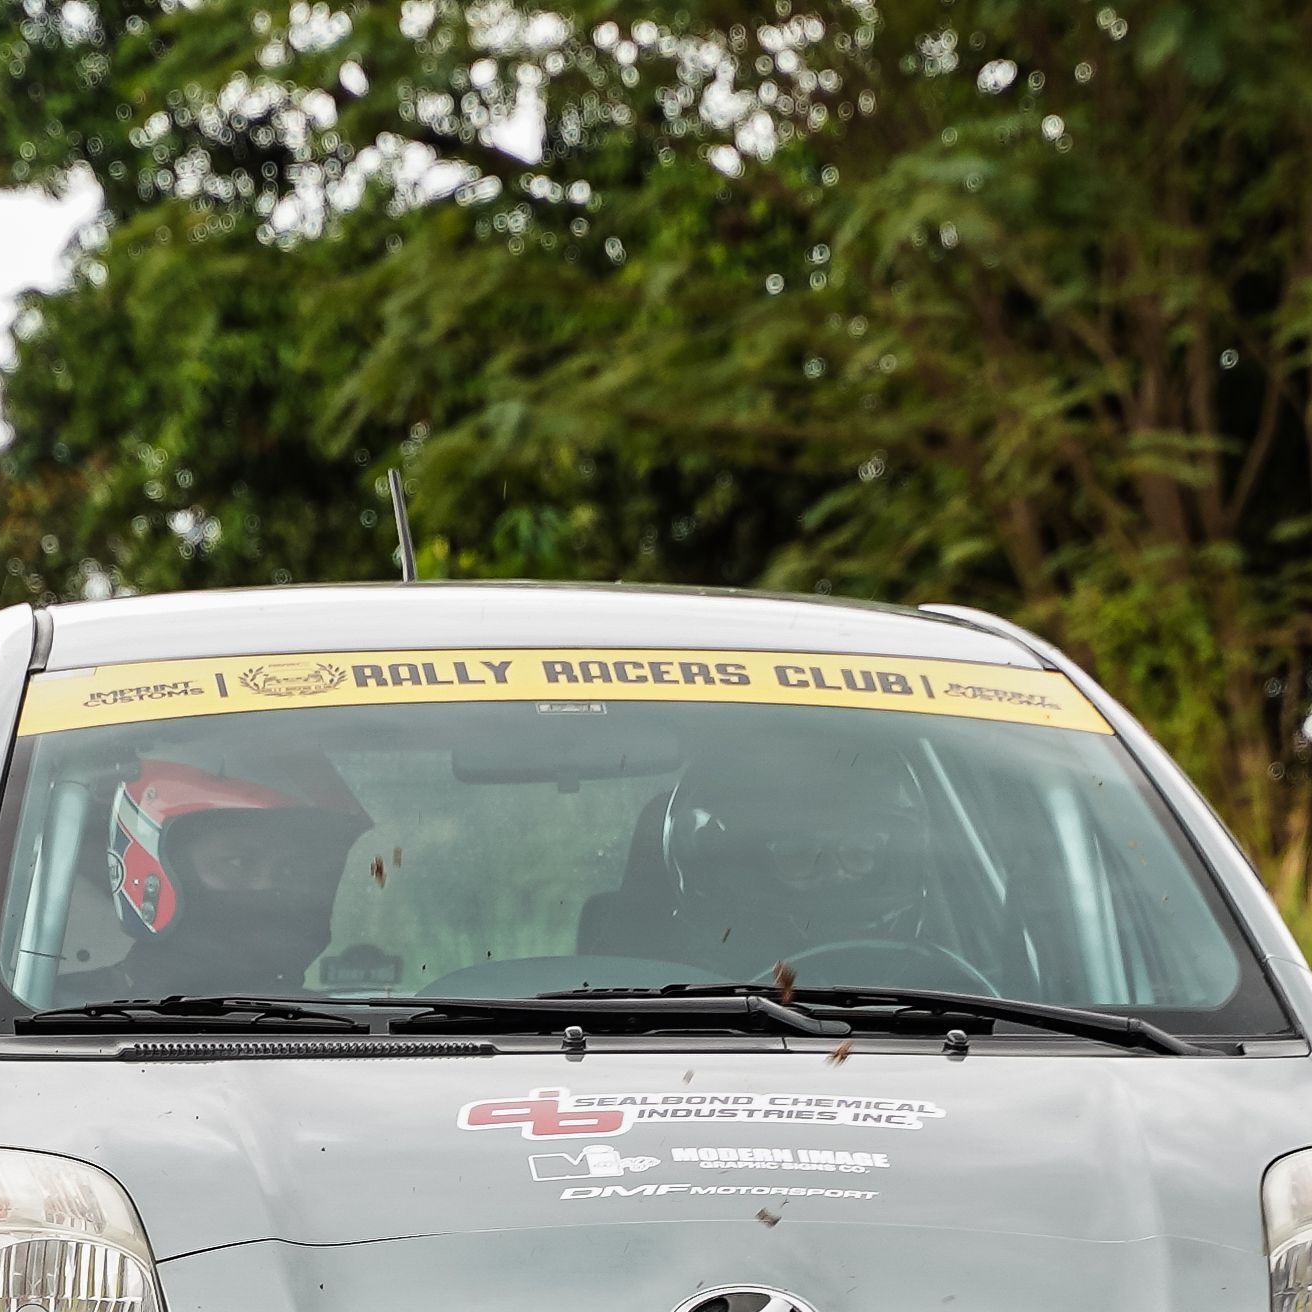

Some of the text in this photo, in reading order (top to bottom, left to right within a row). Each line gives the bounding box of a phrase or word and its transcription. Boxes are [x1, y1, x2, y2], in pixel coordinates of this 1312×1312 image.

[352, 660, 914, 695] RALLY RACERS CLUB
[83, 688, 204, 708] CUSTOMS
[90, 680, 196, 701] IMPRINT
[573, 1095, 936, 1114] SEALBOND CHEMICAL
[637, 1108, 913, 1126] INDUSTRIES INC.
[671, 1147, 890, 1168] MODERN IMAGE
[699, 1161, 779, 1170] GRAPHIC
[781, 1162, 837, 1172] SIGNS
